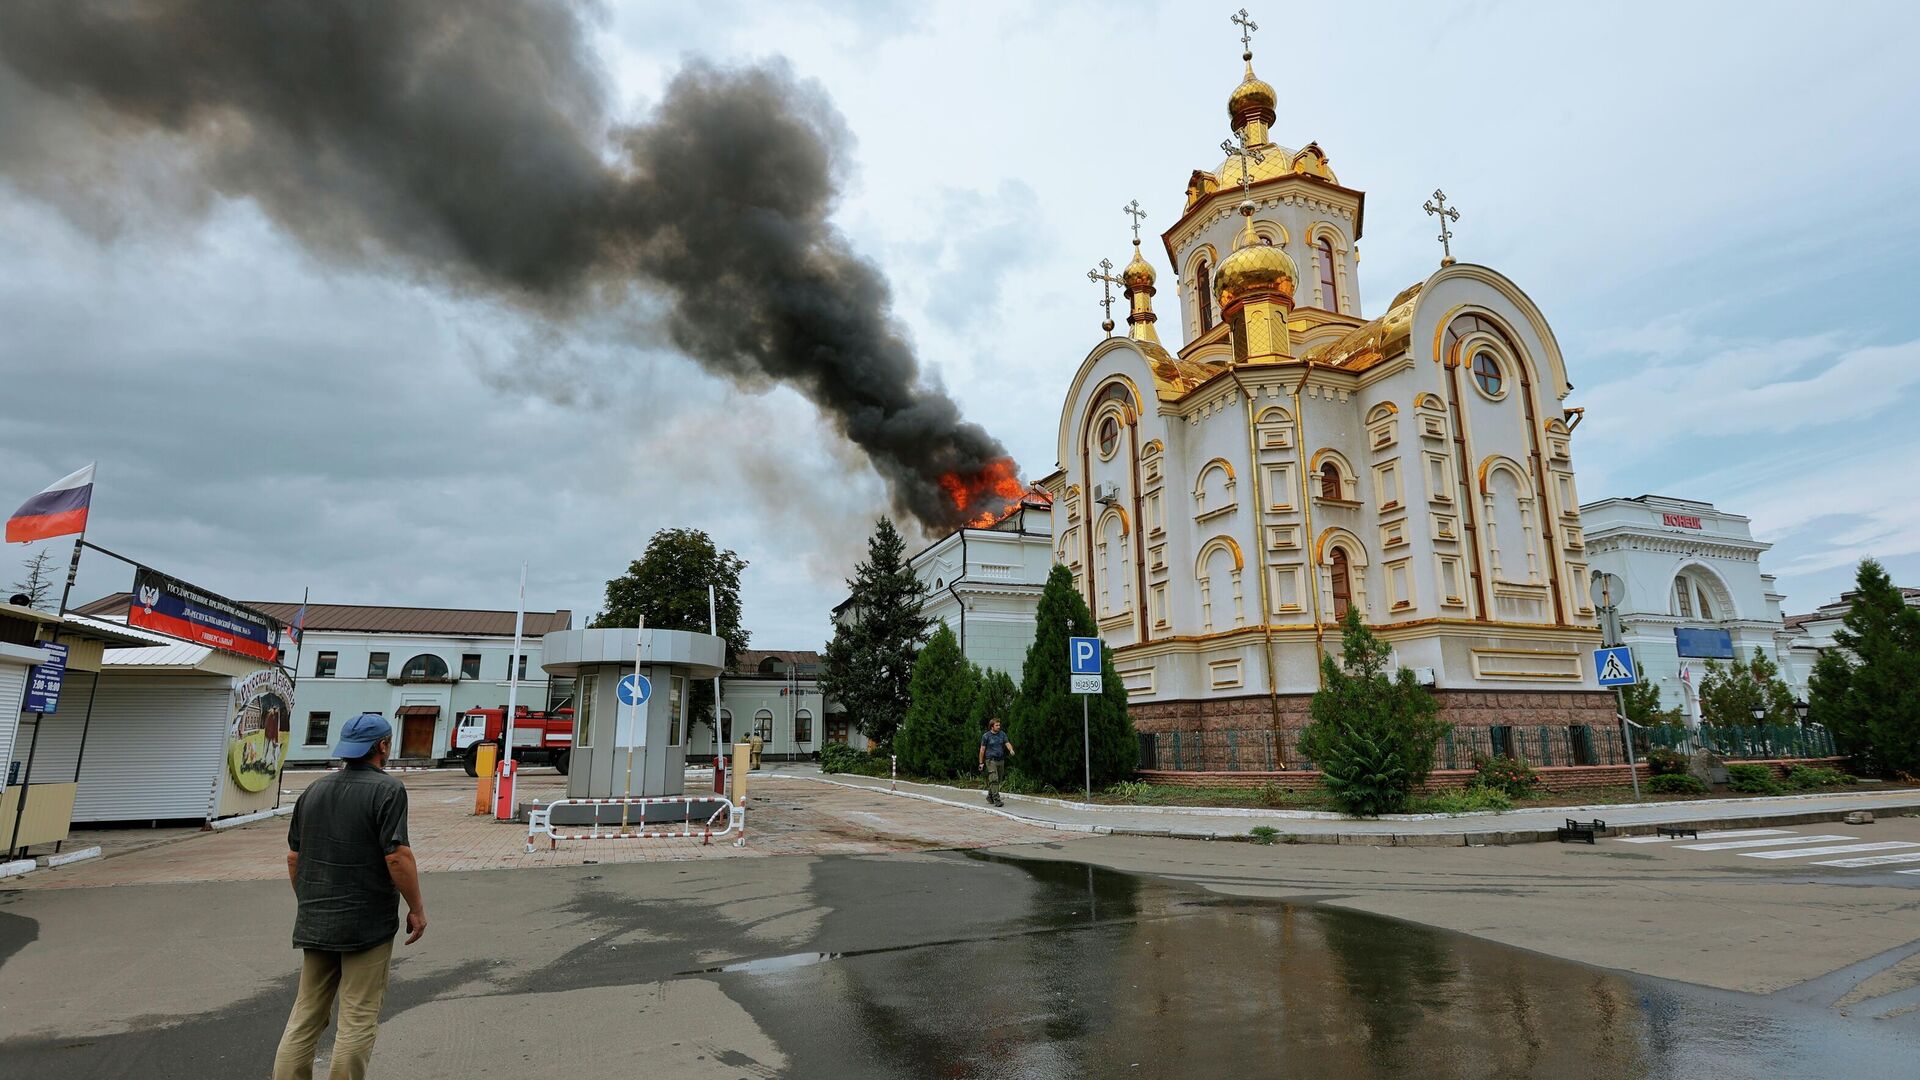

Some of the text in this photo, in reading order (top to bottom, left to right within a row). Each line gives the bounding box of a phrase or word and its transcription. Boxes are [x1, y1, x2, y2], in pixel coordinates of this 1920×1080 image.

[1663, 513, 1702, 529] ДОНЕЦК
[1077, 642, 1093, 669] P
[1090, 680, 1099, 688] 50
